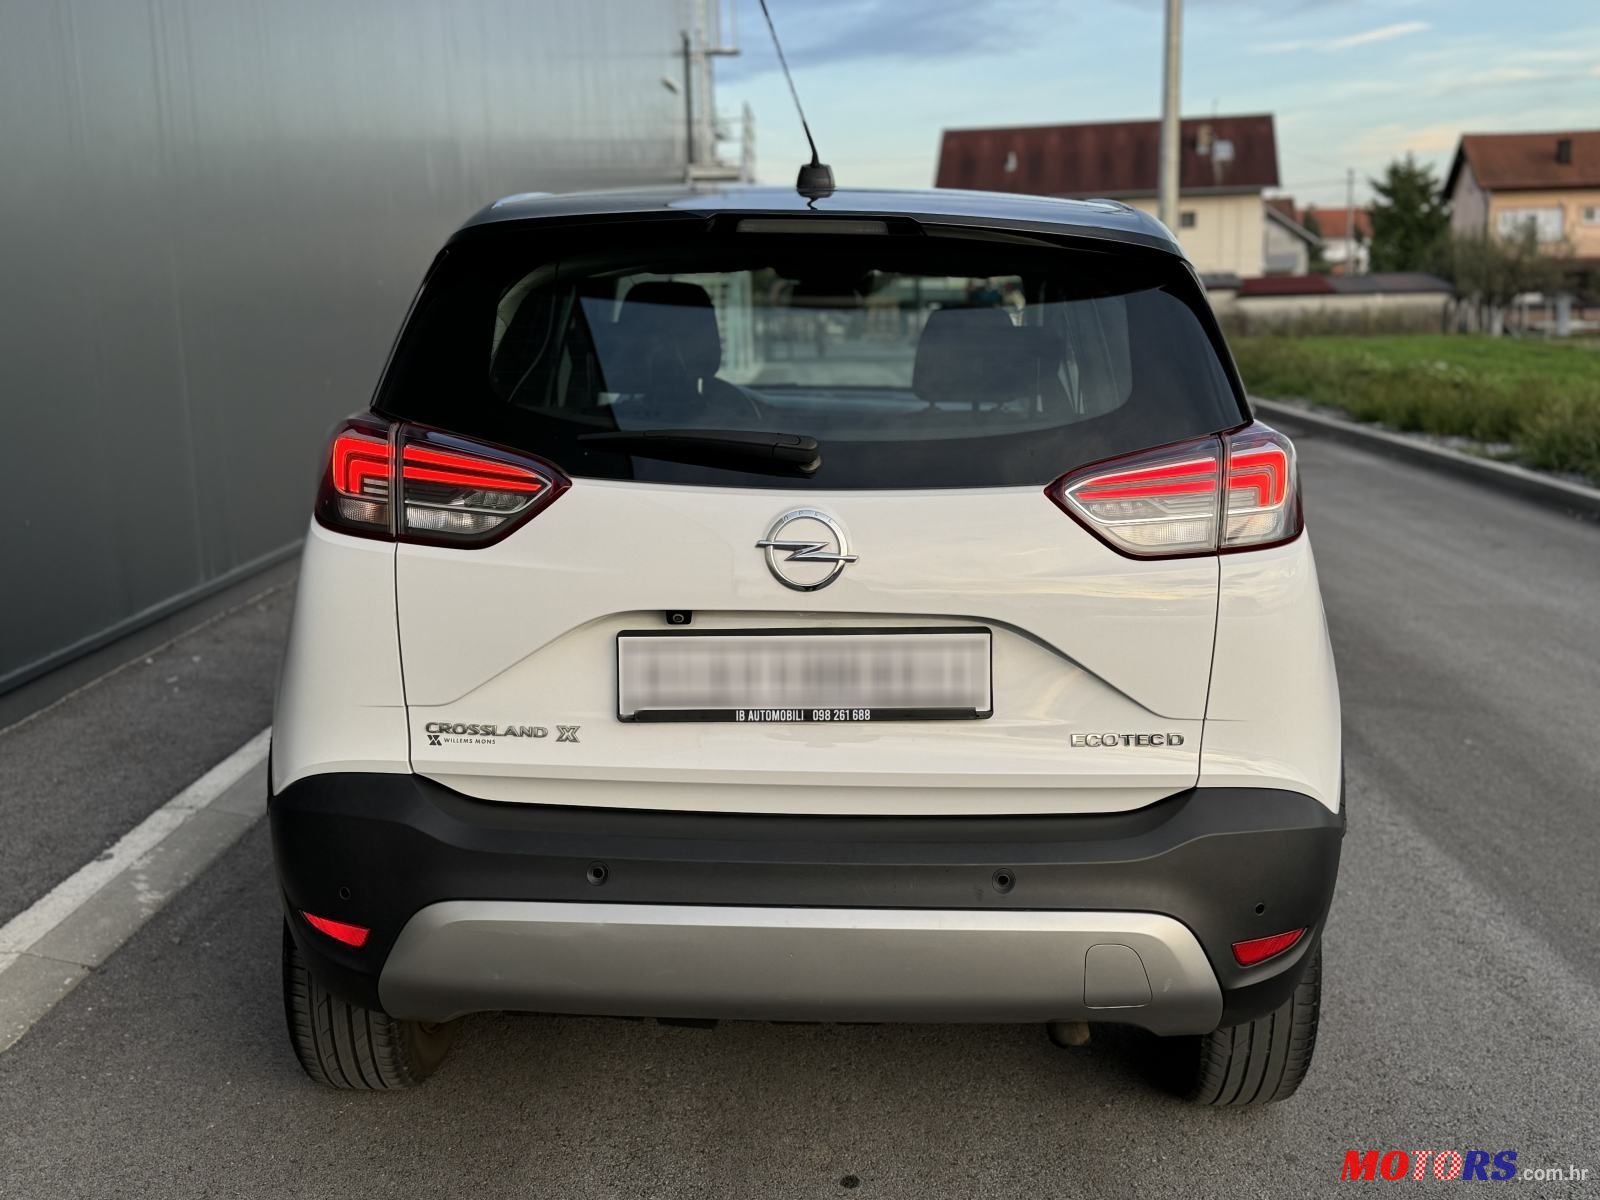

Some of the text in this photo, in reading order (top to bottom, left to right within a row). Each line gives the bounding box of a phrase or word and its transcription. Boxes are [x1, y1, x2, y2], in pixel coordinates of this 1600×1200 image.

[735, 709, 871, 722] IB AUTOMOBILI 098 261 688
[425, 722, 581, 743] CROSSLAND X
